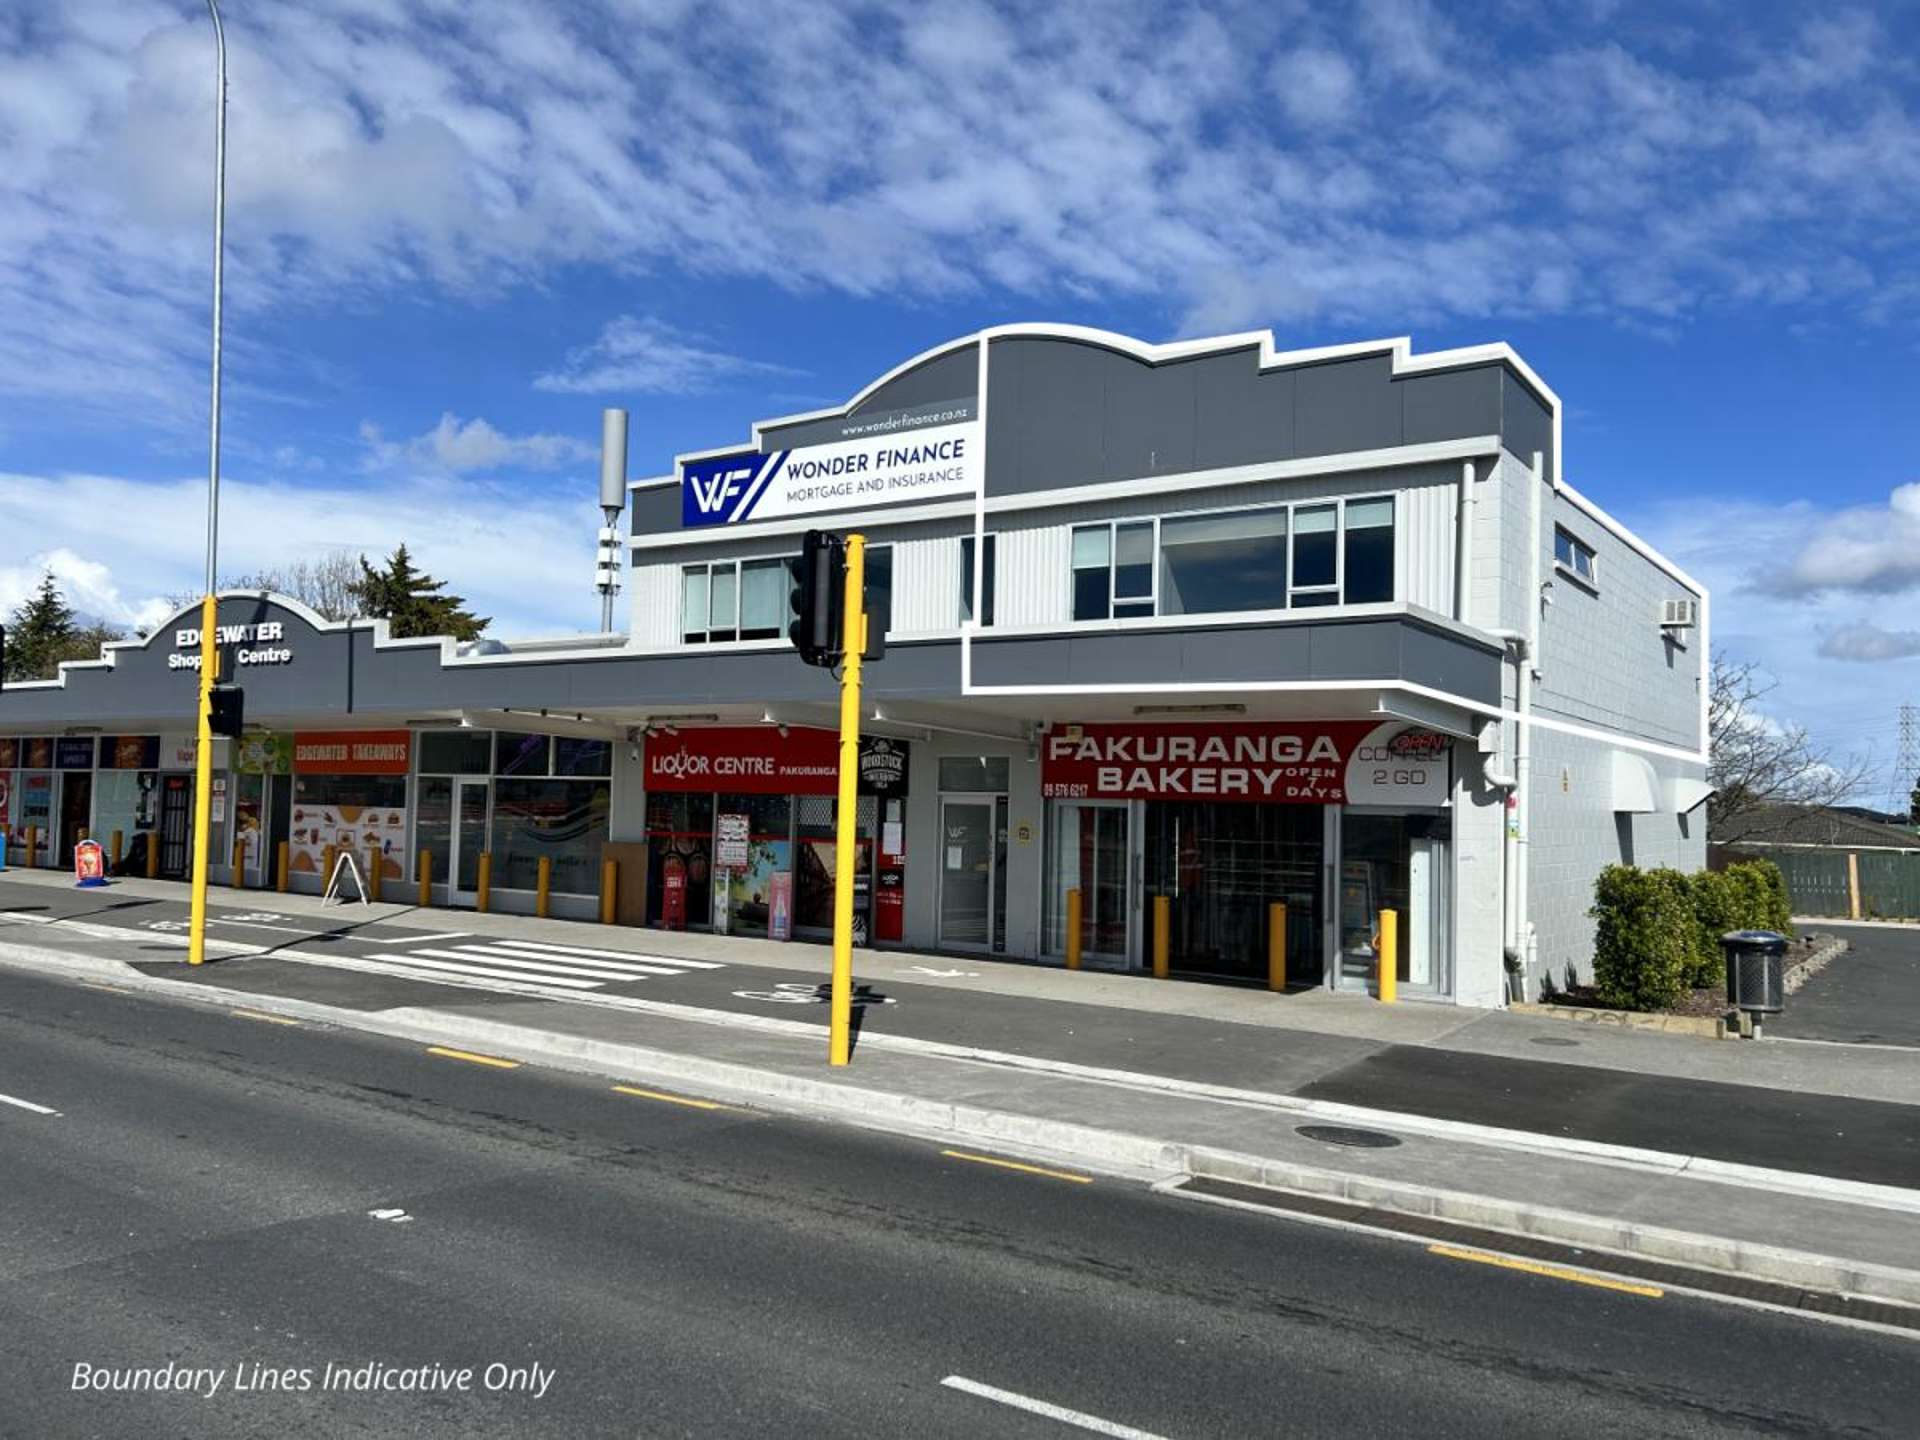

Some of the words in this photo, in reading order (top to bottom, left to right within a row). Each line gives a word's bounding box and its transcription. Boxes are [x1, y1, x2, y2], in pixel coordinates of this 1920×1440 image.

[841, 408, 968, 436] www.wonderfinance.co.nz
[787, 455, 868, 480] WONDER
[875, 438, 965, 470] FINANCE
[690, 467, 752, 513] WF
[786, 485, 853, 503] MORTGAGE
[856, 478, 885, 494] AND
[888, 467, 964, 490] INSURANCE
[175, 622, 283, 648] EDEWATER
[238, 648, 291, 665] Centre
[296, 744, 348, 761] EDGEWATER
[352, 744, 405, 761] TAKEAWAYS
[1050, 736, 1341, 762] PAKURANGA
[652, 745, 710, 780] LIQUOR
[714, 757, 775, 775] CENTRE
[779, 766, 838, 776] PAKURANGA
[1285, 767, 1337, 778] OPEN
[1098, 767, 1282, 794] BAKERY
[1308, 778, 1317, 789] 7
[1373, 770, 1389, 785] 2
[1394, 770, 1427, 785] GO
[1287, 786, 1343, 798] DAYS
